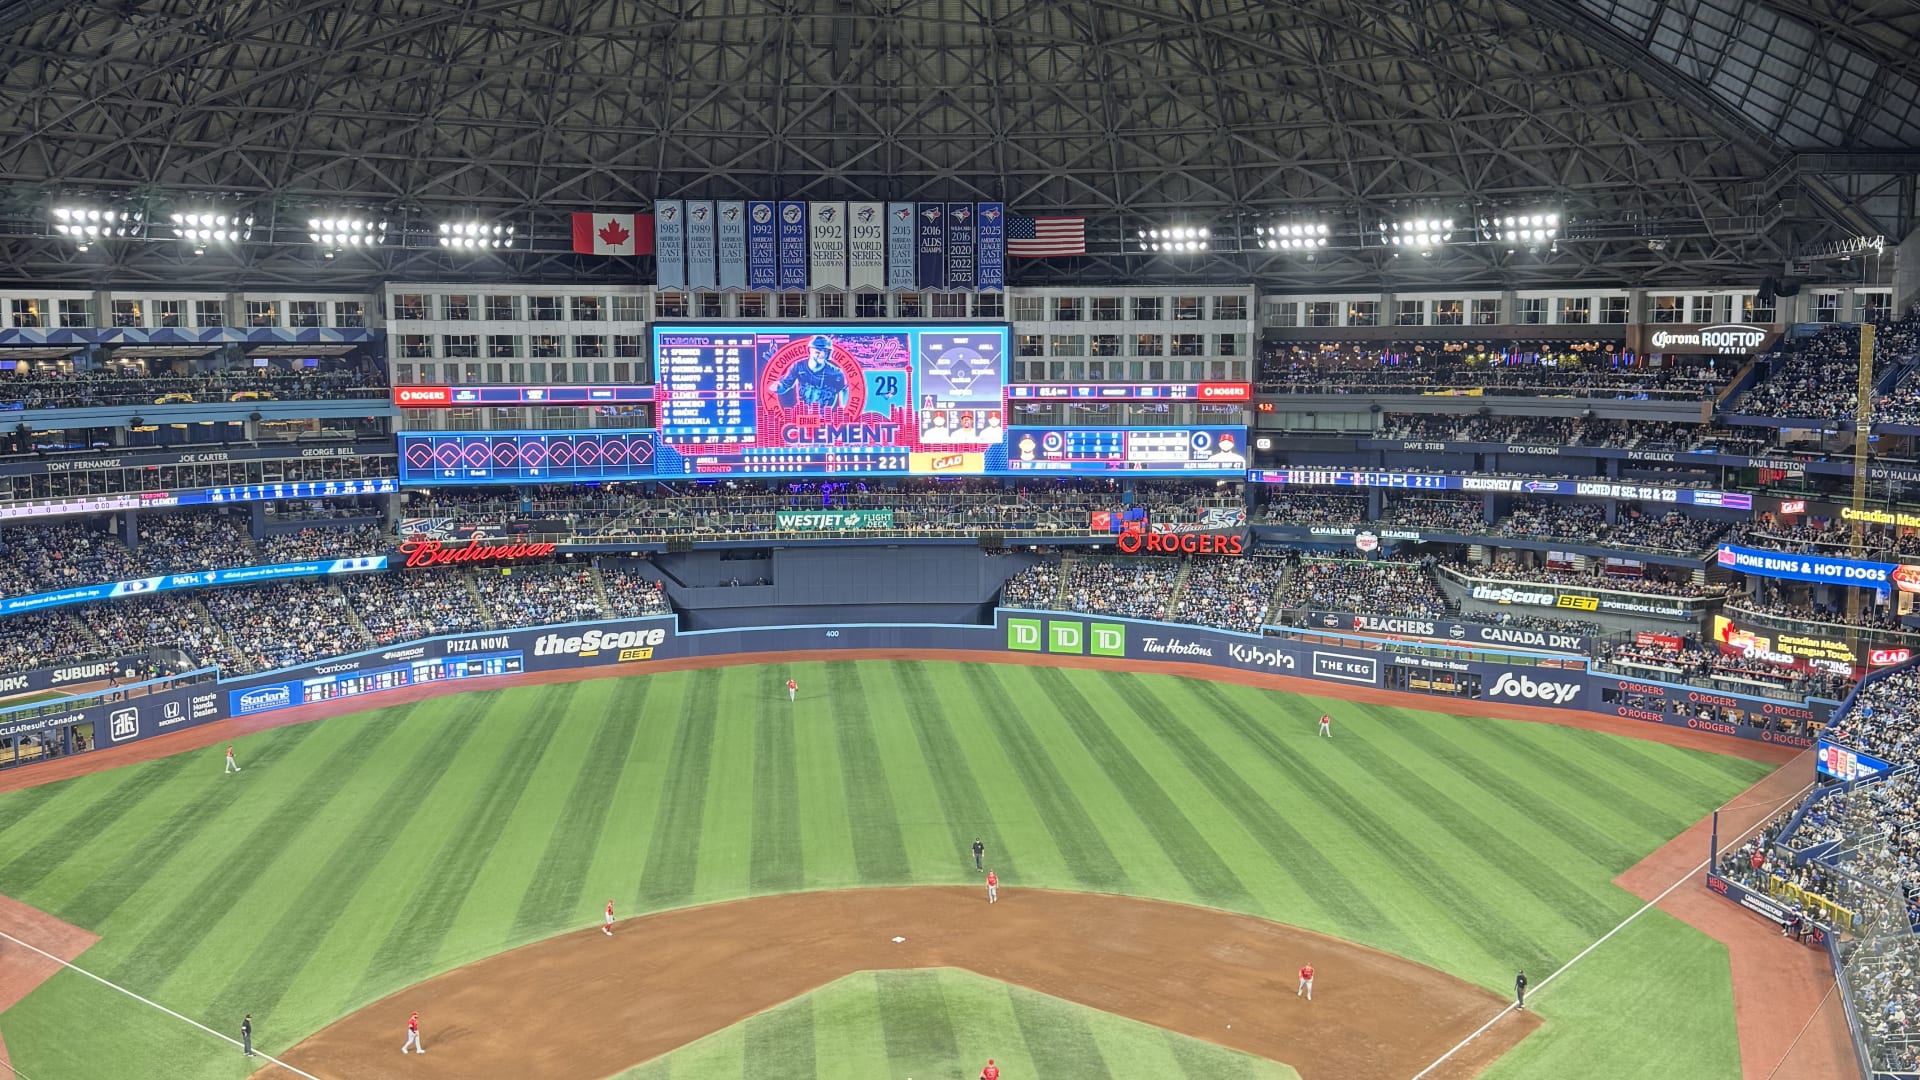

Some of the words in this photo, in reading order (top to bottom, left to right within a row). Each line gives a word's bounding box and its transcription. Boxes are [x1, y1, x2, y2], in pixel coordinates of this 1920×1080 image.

[660, 224, 679, 233] 1985
[692, 225, 710, 234] 1989
[723, 225, 740, 234] 1991
[752, 226, 772, 234] 1992
[783, 226, 802, 234] 1993
[814, 226, 842, 238] 1992
[852, 226, 880, 238] 1993
[892, 226, 910, 235] 2015
[922, 226, 940, 235] 2016
[981, 226, 1000, 234] 2025
[922, 238, 942, 246] ALDS
[952, 232, 970, 241] 2016
[813, 242, 843, 250] WORLD
[852, 242, 882, 250] WORLD
[950, 246, 972, 255] 2020
[752, 250, 773, 258] EAST
[783, 250, 803, 258] EAST
[813, 251, 844, 260] SERIES
[852, 251, 882, 260] SERIES
[892, 250, 911, 258] EAST
[981, 250, 1000, 258] EAST
[950, 259, 972, 268] 2022
[753, 268, 774, 278] ALCS
[784, 268, 804, 278] ALCS
[950, 272, 972, 282] 2023
[981, 268, 1001, 278] ALCS
[1652, 331, 1700, 348] Corona
[1701, 332, 1765, 346] ROOFTOP
[875, 376, 898, 396] 2B
[411, 392, 445, 400] ROGERS
[1214, 388, 1244, 396] ROGERS
[782, 423, 898, 444] CLEMENT
[1404, 442, 1422, 450] DAVE
[1424, 442, 1445, 450] STIEB
[1528, 447, 1559, 455] GASTON
[198, 453, 228, 462] CARTER
[302, 448, 334, 456] GEORGE
[1628, 452, 1641, 460] PAT
[1643, 452, 1674, 462] GILLICK
[46, 462, 70, 471] TONY
[74, 459, 121, 470] FERNANDEZ
[878, 456, 887, 470] 2
[888, 456, 896, 470] 2
[932, 456, 963, 470] GLAD
[1748, 459, 1768, 468] PAUL
[1770, 462, 1806, 471] BEESTON
[1872, 469, 1888, 478] ROY
[1462, 479, 1509, 491] EXCLUSIVELY
[1511, 480, 1522, 491] AT
[1577, 483, 1610, 495] LOCATED
[1611, 486, 1620, 496] AT
[1622, 486, 1638, 498] SEC.
[1639, 487, 1652, 499] 112
[1662, 488, 1676, 501] 123
[1782, 502, 1804, 512] GLAD
[1841, 507, 1894, 524] Canadian
[779, 514, 843, 530] WESTJET
[1310, 527, 1340, 535] CANADA
[1381, 530, 1419, 539] BLEACHERS
[1147, 533, 1242, 554] ROGERS
[400, 540, 555, 567] Budweiser
[1737, 554, 1763, 567] HOME
[1765, 559, 1798, 572] RUNS
[1801, 563, 1811, 574] &
[1815, 564, 1842, 577] HOT
[1845, 568, 1886, 580] DOGS
[173, 575, 199, 585] PATH
[1473, 586, 1554, 605] theScore
[1559, 596, 1597, 609] BET
[1603, 601, 1649, 612] SPORTSBOOK
[1656, 607, 1683, 616] CASINO
[1011, 624, 1038, 644] TD
[1052, 627, 1078, 647] TD
[1094, 629, 1121, 649] TD
[1481, 627, 1546, 645] CANADA
[1550, 634, 1581, 649] DRY.
[447, 640, 478, 653] PIZZA
[480, 638, 509, 650] NOVA
[534, 628, 665, 656] theScore
[1142, 637, 1165, 653] Tim
[1166, 638, 1213, 657] Hortons
[1778, 635, 1819, 647] Canadian
[1821, 640, 1849, 651] Made.
[622, 649, 650, 659] BET
[1229, 642, 1295, 670] Kubota
[1777, 643, 1792, 653] Big
[1793, 646, 1825, 658] League
[1827, 650, 1857, 662] Tough.
[1872, 651, 1908, 663] GLAD
[1395, 656, 1419, 665] Active
[1321, 660, 1342, 670] THE
[1346, 663, 1369, 674] KEG
[1490, 672, 1580, 704] Sobeys
[1629, 683, 1664, 696] ROGERS
[193, 692, 217, 704] Ontario
[1700, 694, 1736, 707] ROGERS
[193, 701, 213, 711] Honda
[193, 706, 218, 719] Dealers
[1627, 709, 1664, 722] ROGERS
[1775, 706, 1813, 719] ROGERS
[48, 715, 77, 726] Canada
[159, 716, 186, 727] HONDA
[0, 720, 45, 736] CLEAResult
[1699, 721, 1735, 735] ROGERS
[1774, 733, 1812, 746] ROGERS
[1709, 876, 1728, 894] HEINZ
